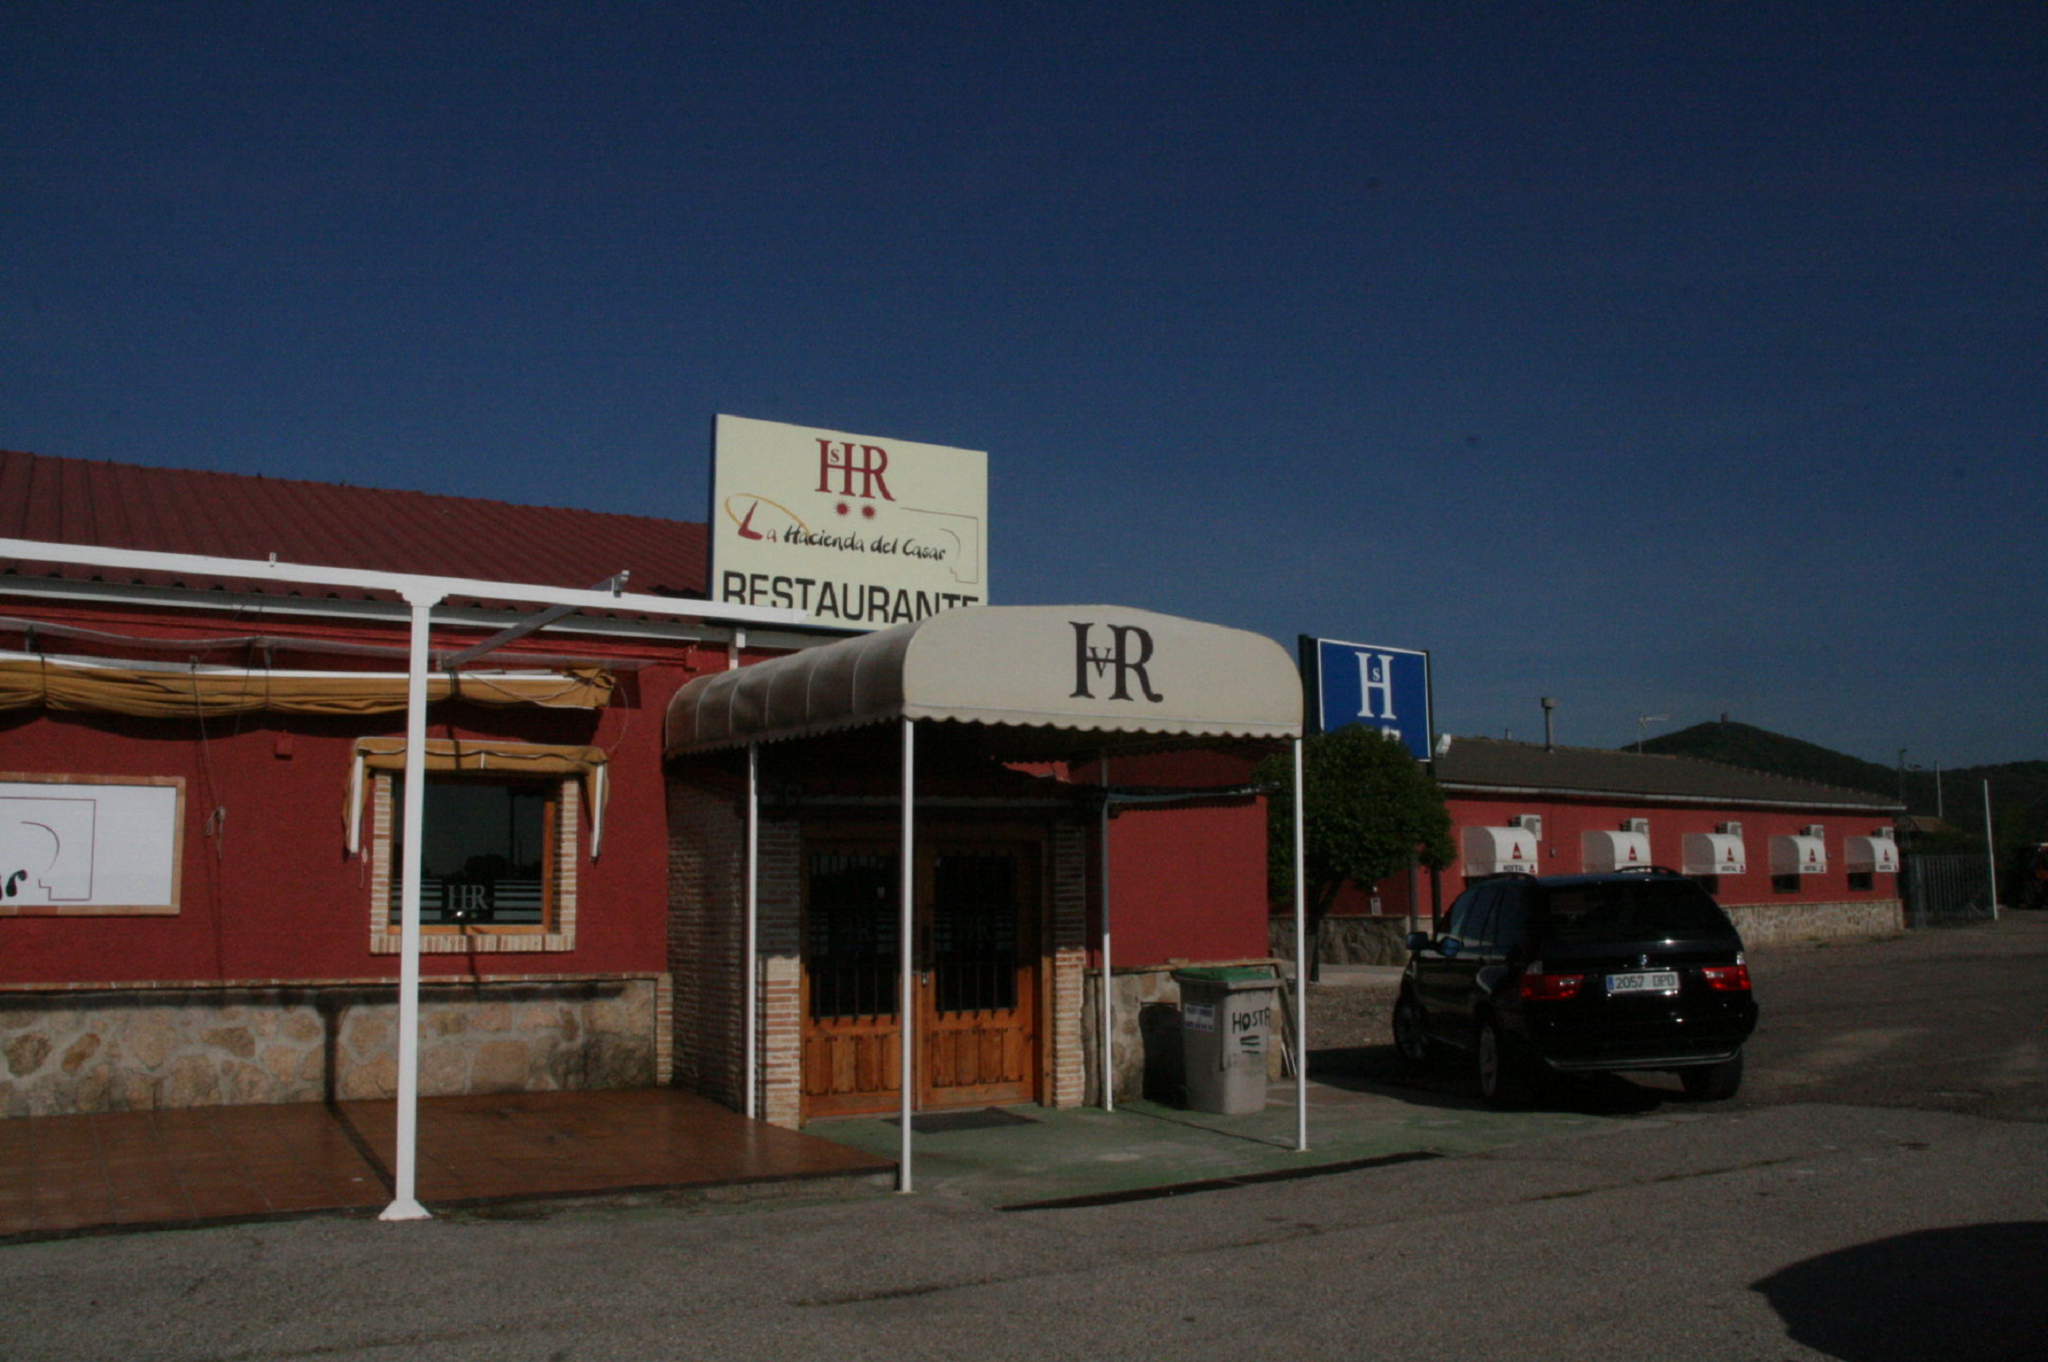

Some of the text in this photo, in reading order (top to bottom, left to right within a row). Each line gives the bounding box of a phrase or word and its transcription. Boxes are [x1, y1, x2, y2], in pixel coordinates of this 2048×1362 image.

[737, 500, 946, 561] La Hacienda del Casar
[722, 570, 980, 624] RESTAURAN
[1615, 975, 1645, 990] 2057
